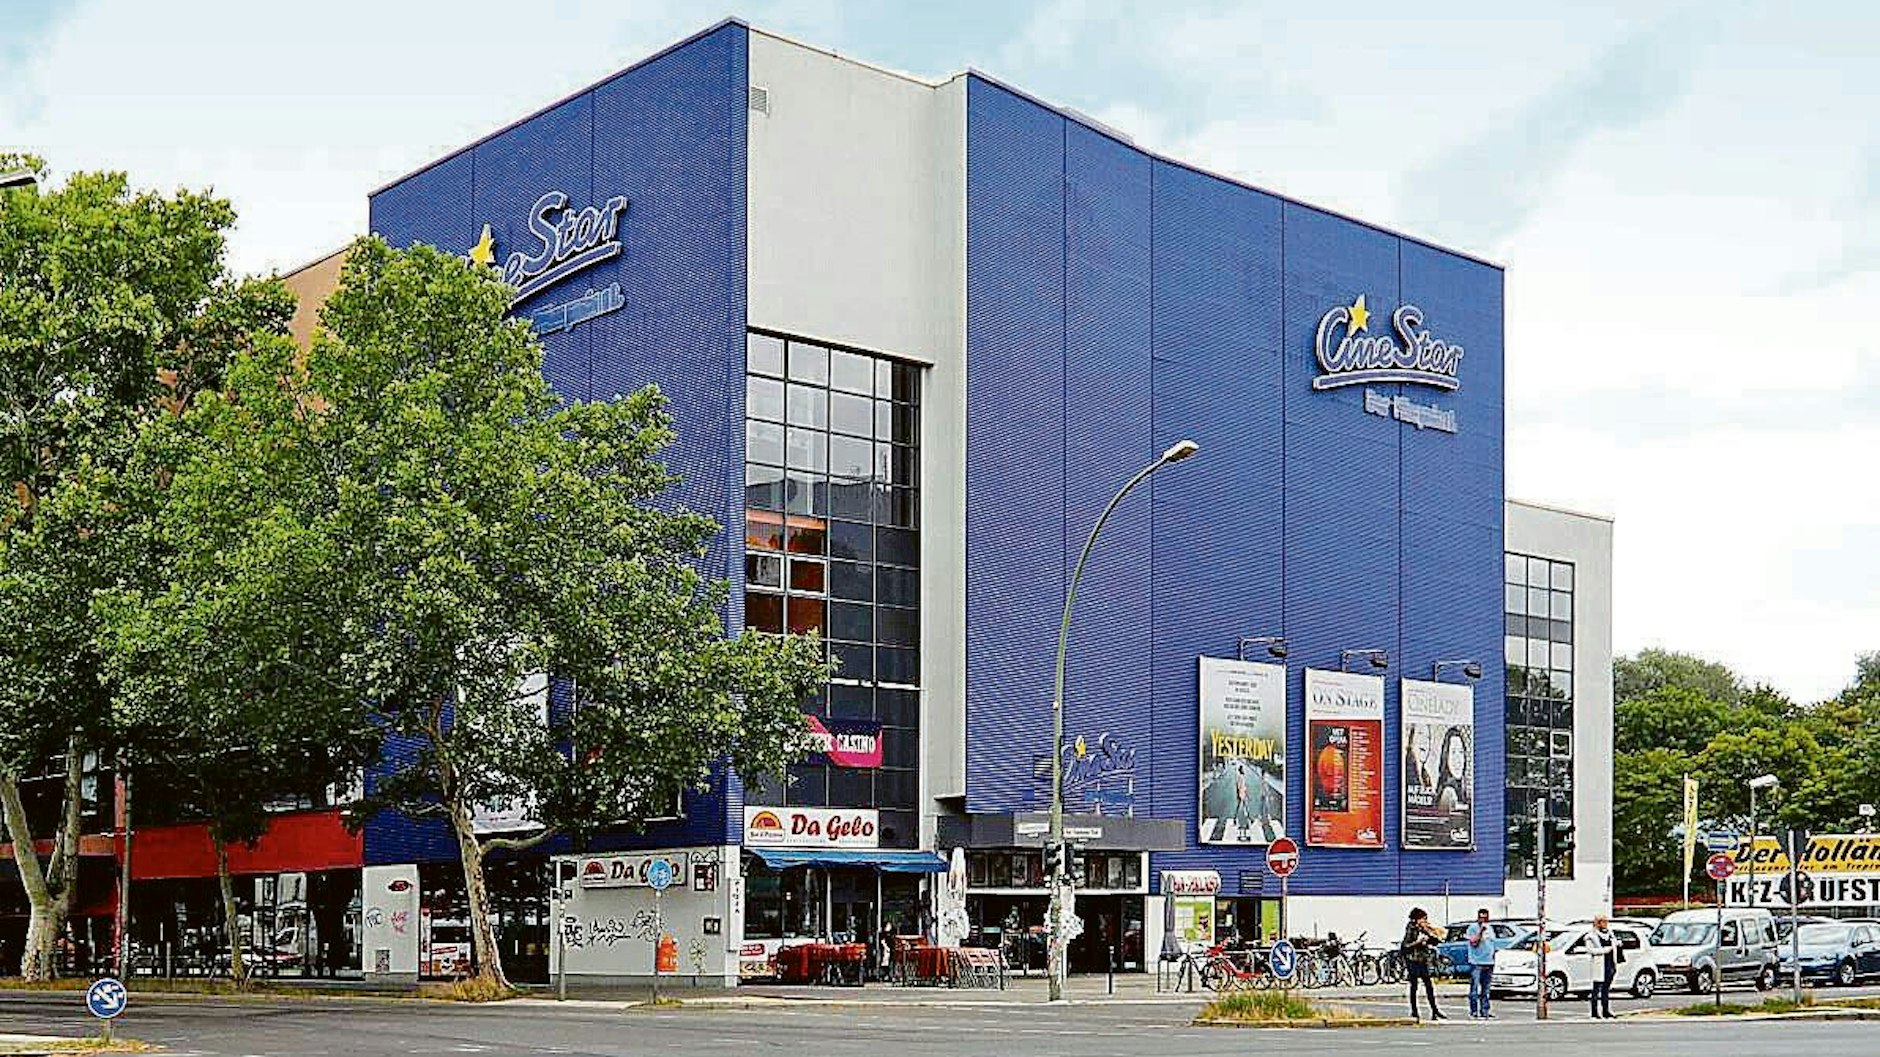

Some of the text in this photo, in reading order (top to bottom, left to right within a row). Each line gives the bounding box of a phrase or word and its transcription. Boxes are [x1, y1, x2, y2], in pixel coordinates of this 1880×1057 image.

[1316, 304, 1464, 376] CineStar
[836, 733, 876, 754] CASINO
[1210, 729, 1275, 761] YESTERDAY
[791, 814, 874, 841] Da Gelo
[611, 861, 634, 879] Da
